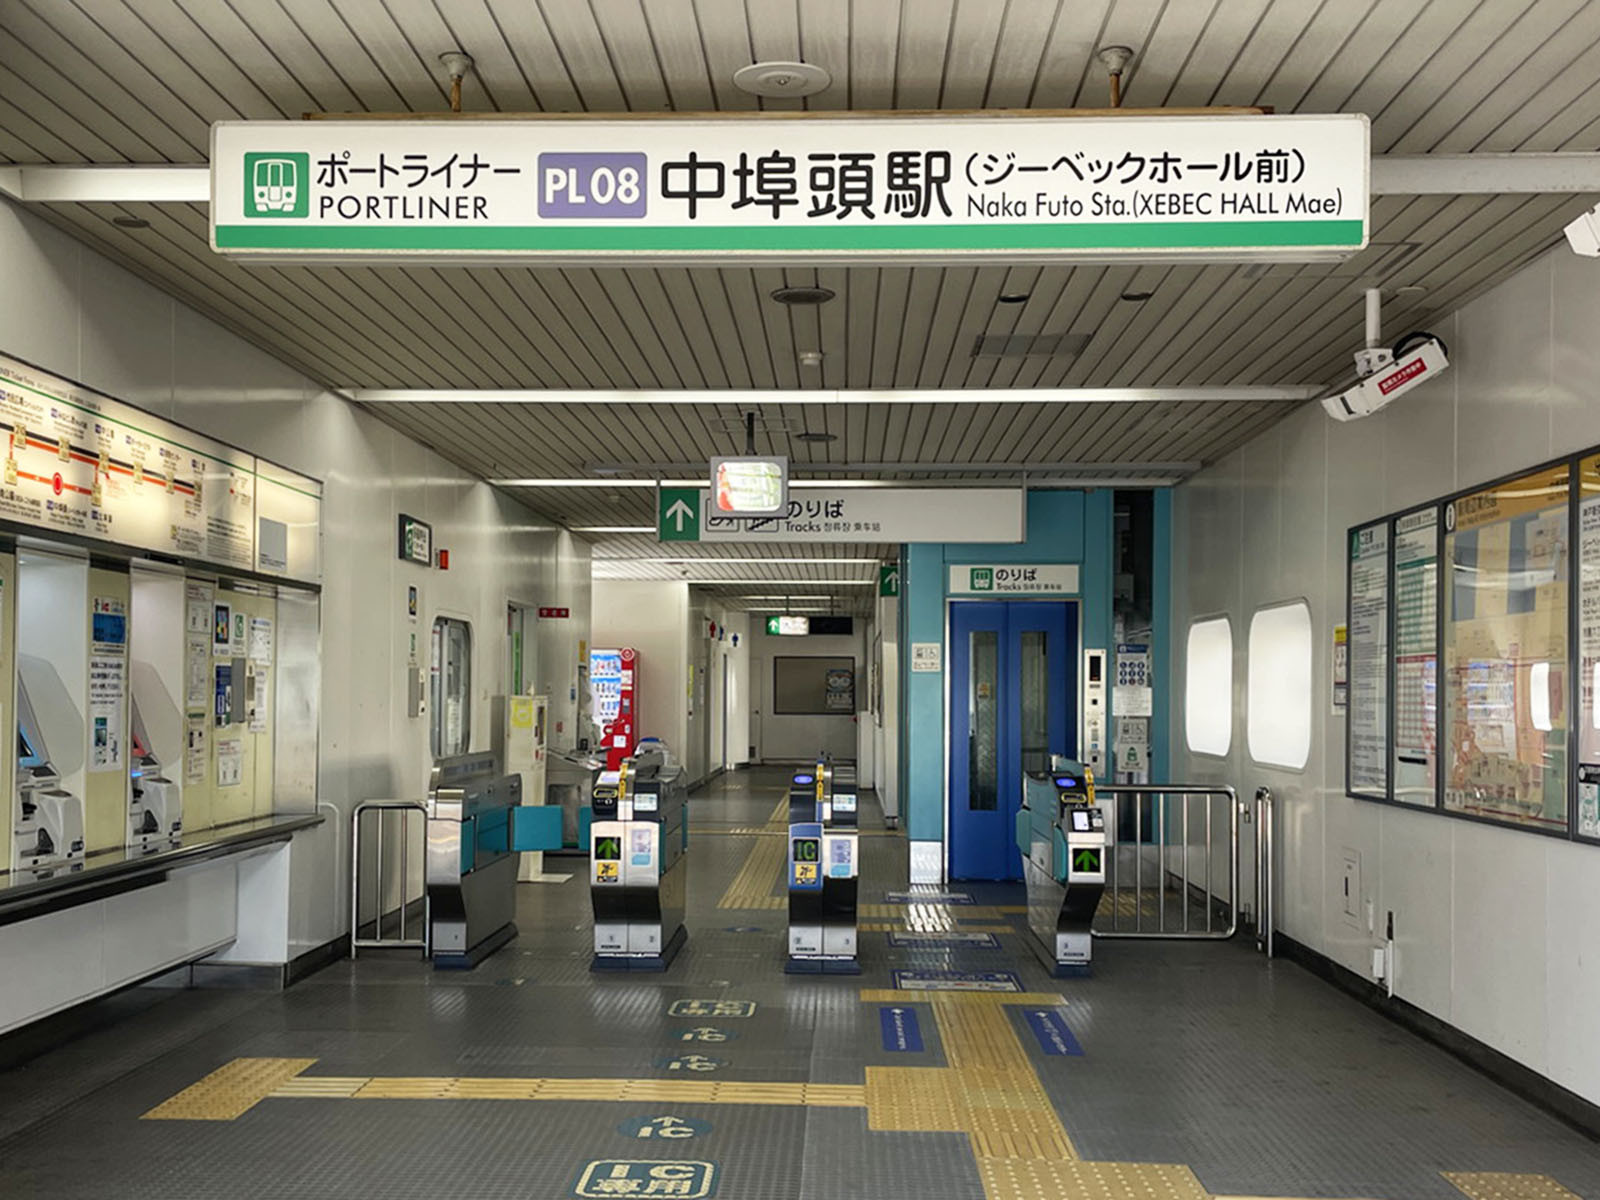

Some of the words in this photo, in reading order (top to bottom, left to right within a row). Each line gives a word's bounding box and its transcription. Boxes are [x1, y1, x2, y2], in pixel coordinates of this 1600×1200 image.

[316, 150, 521, 188] ポートライナー
[660, 149, 953, 220] 中埠頭駅
[319, 195, 489, 219] PORTLINER
[967, 192, 1027, 218] Naka
[1035, 192, 1084, 217] Futo
[1220, 191, 1279, 216] HALL
[1286, 188, 1342, 216] Mae)
[788, 499, 845, 518] のりば
[785, 521, 821, 532] Tracks
[995, 568, 1038, 581] のりば
[797, 841, 816, 860] IC
[682, 1033, 727, 1042] IC
[668, 1062, 718, 1072] IC
[637, 1126, 695, 1138] IC
[610, 1164, 696, 1179] IC
